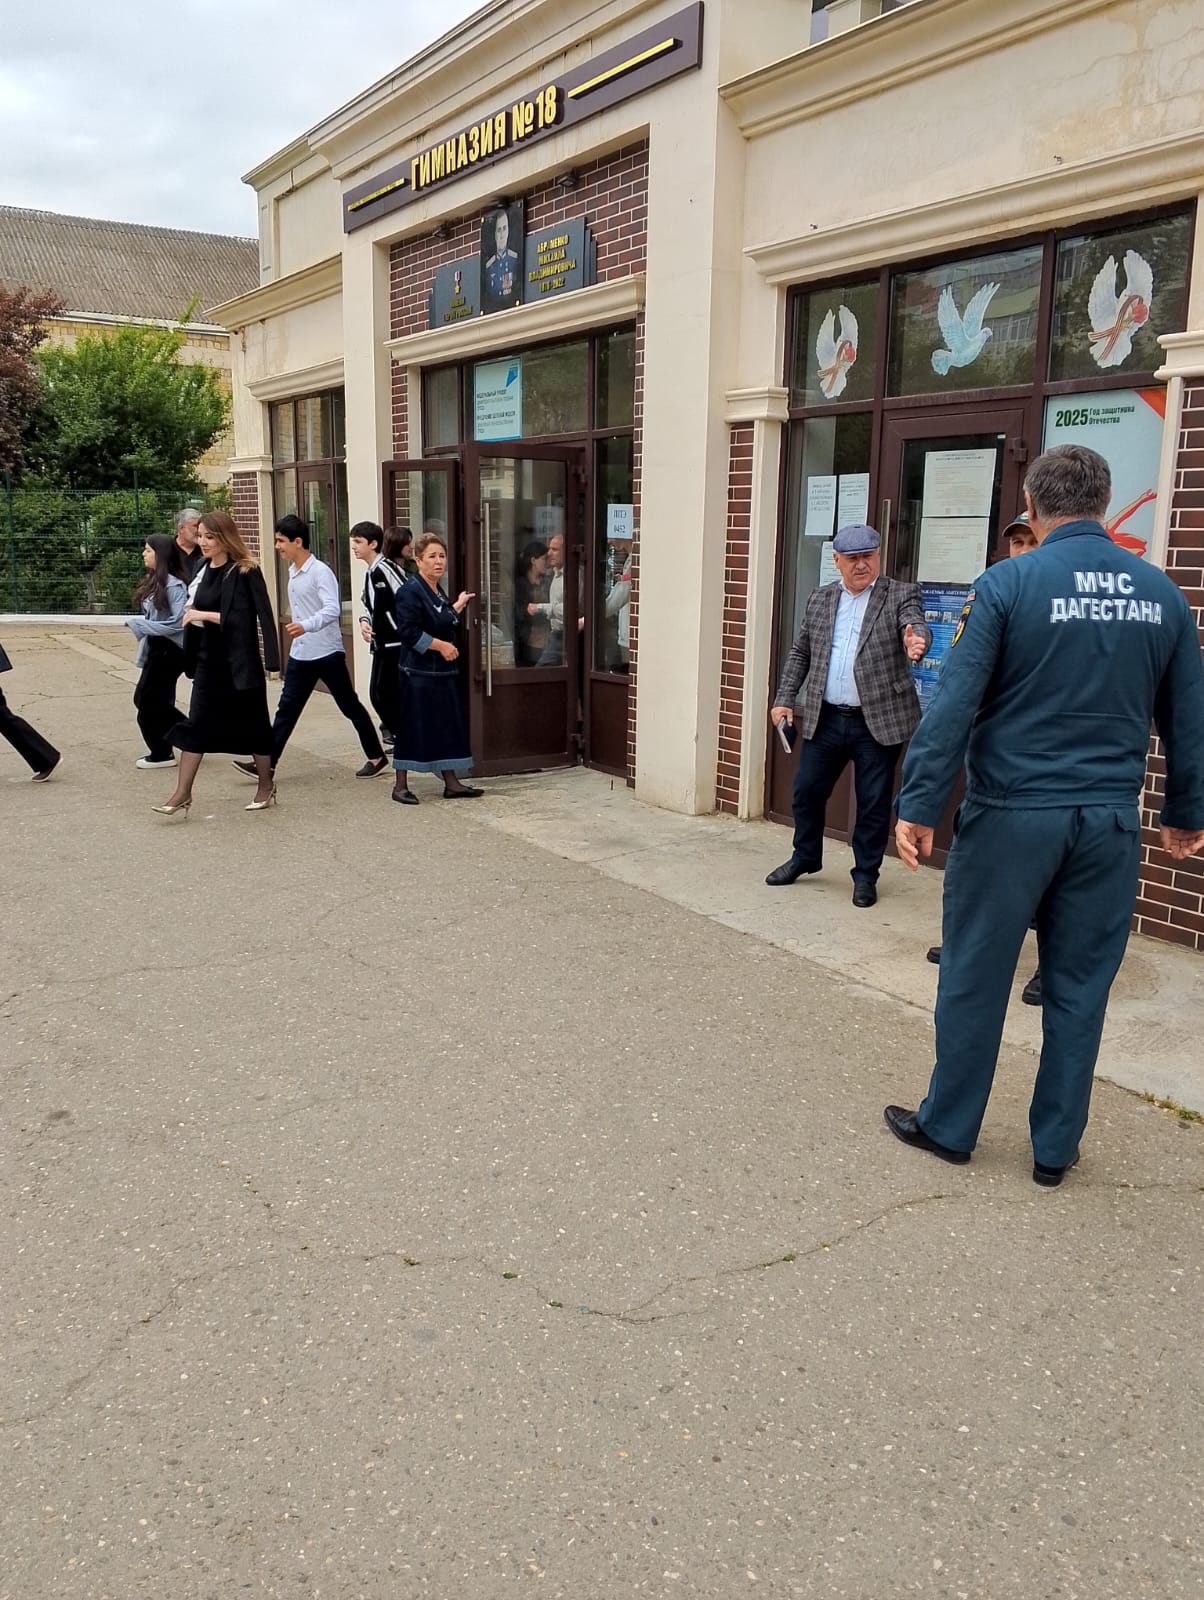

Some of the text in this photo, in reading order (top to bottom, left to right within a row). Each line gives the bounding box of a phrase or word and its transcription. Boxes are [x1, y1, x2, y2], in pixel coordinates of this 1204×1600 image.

[411, 110, 506, 191] ГИМНАЗИЯ
[1055, 408, 1089, 427] 2025
[1088, 416, 1120, 425] Отечества
[1089, 406, 1135, 416] Год защитника
[1073, 571, 1135, 595] МЧС
[1050, 597, 1162, 624] ДАГЕСТАНА
